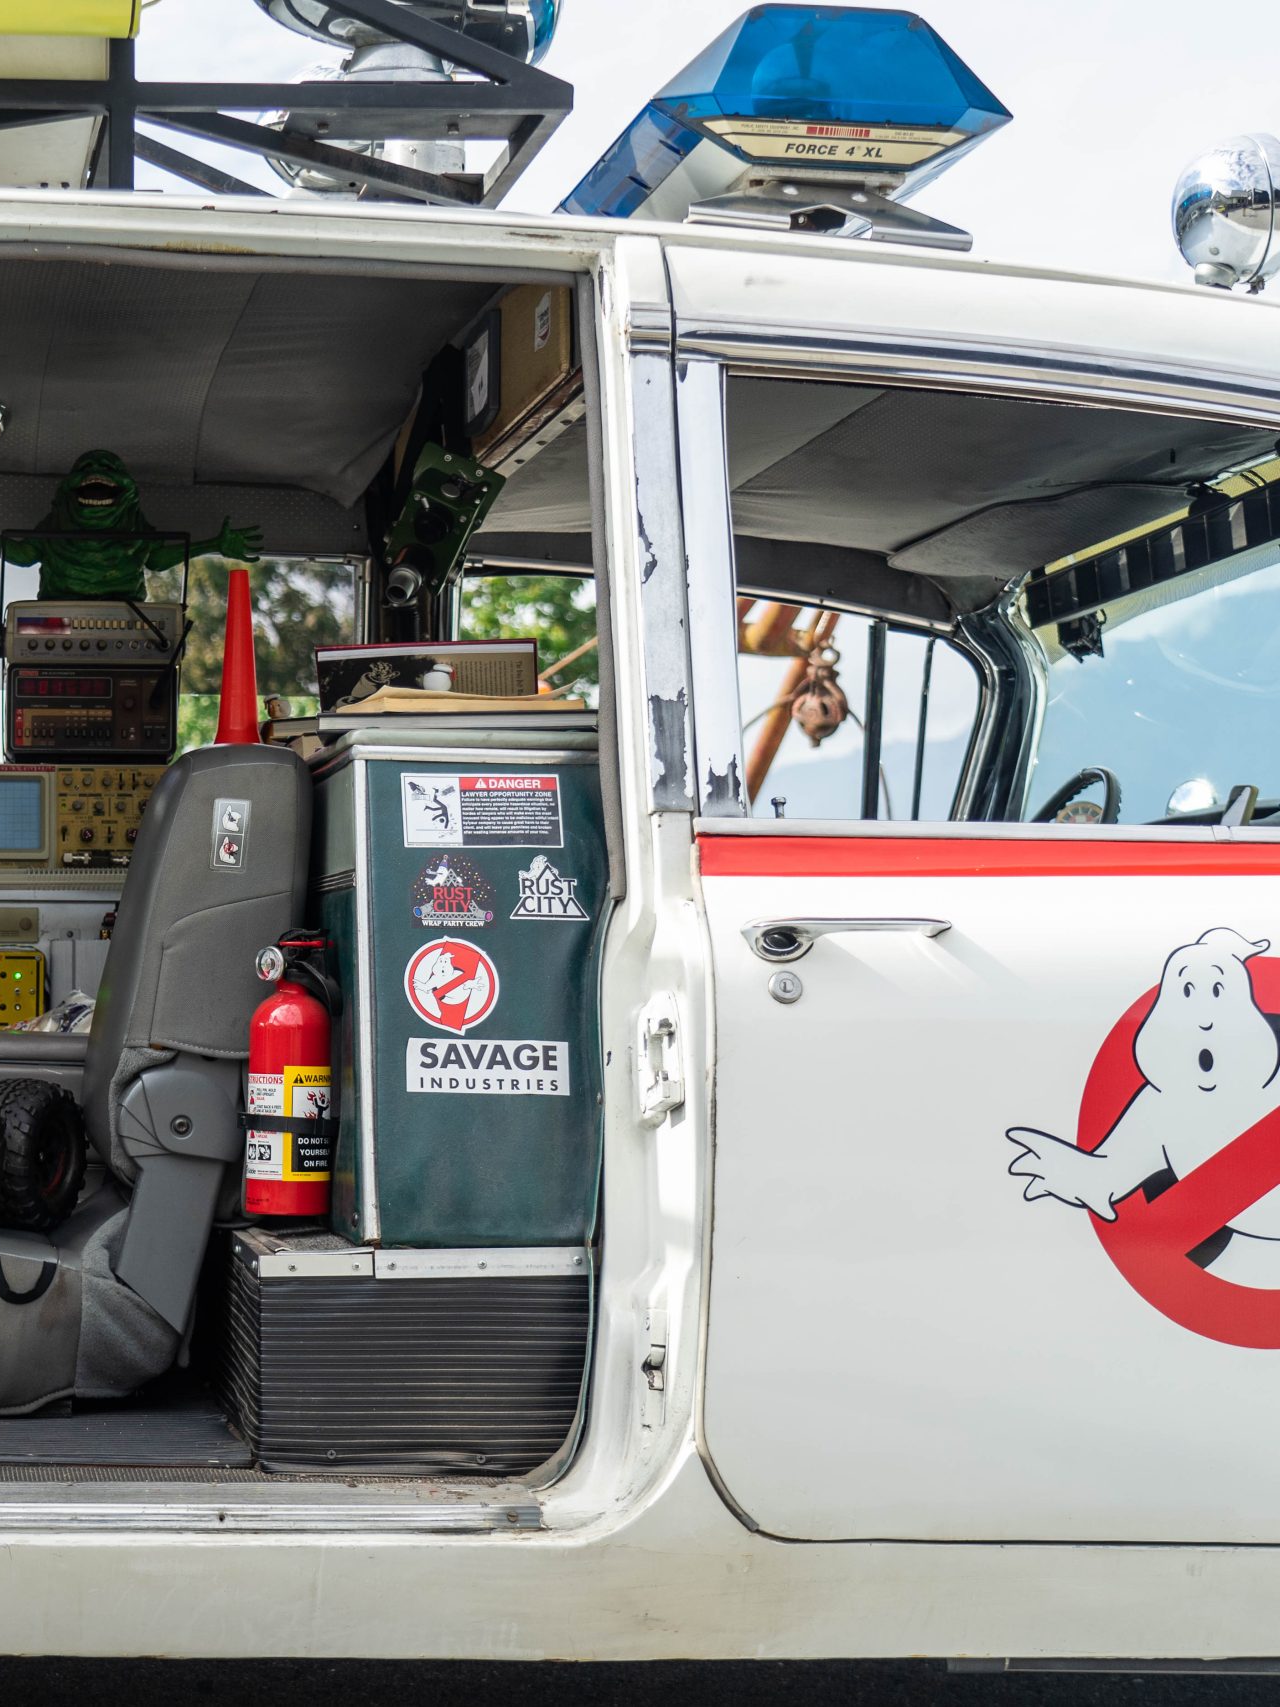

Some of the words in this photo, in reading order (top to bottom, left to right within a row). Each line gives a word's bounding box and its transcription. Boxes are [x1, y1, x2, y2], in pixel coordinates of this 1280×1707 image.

[785, 143, 838, 155] FORCE
[846, 146, 856, 156] 4
[862, 146, 883, 158] XL
[488, 780, 540, 788] DANGER
[434, 887, 473, 900] RUST
[522, 878, 576, 896] RUST
[434, 900, 472, 912] CITY
[522, 897, 573, 914] CITY
[420, 1042, 558, 1071] SAVAGE
[304, 1074, 331, 1082] WARN
[420, 1076, 559, 1092] INDUSTRIES
[300, 1148, 329, 1156] YOURSEL
